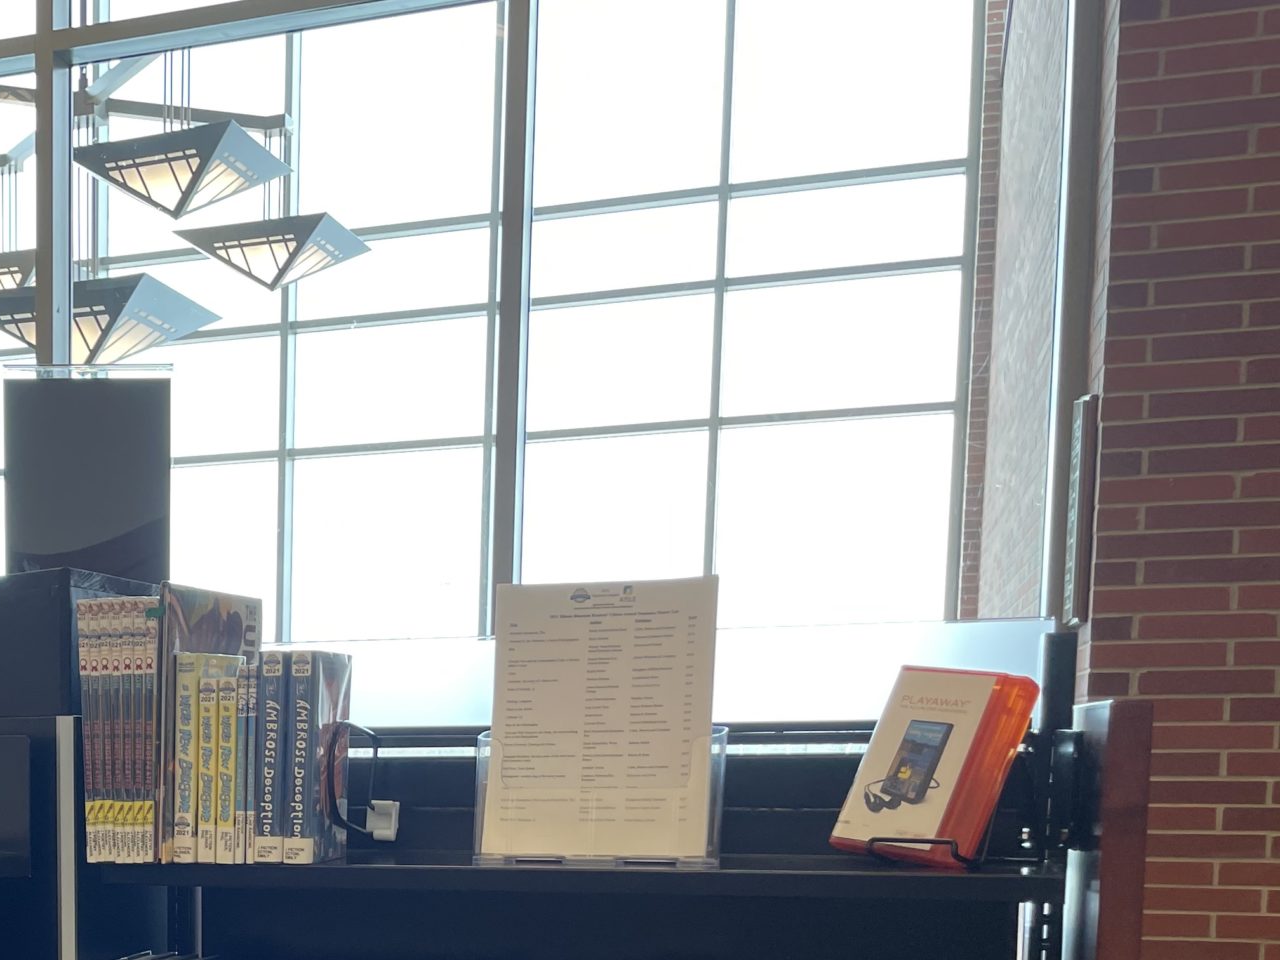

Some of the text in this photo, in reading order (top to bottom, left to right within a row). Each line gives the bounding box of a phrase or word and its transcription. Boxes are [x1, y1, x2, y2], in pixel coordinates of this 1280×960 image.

[264, 700, 280, 764] AMBROSE
[295, 700, 310, 764] AMBROSE
[902, 695, 966, 707] PLAYAWAY
